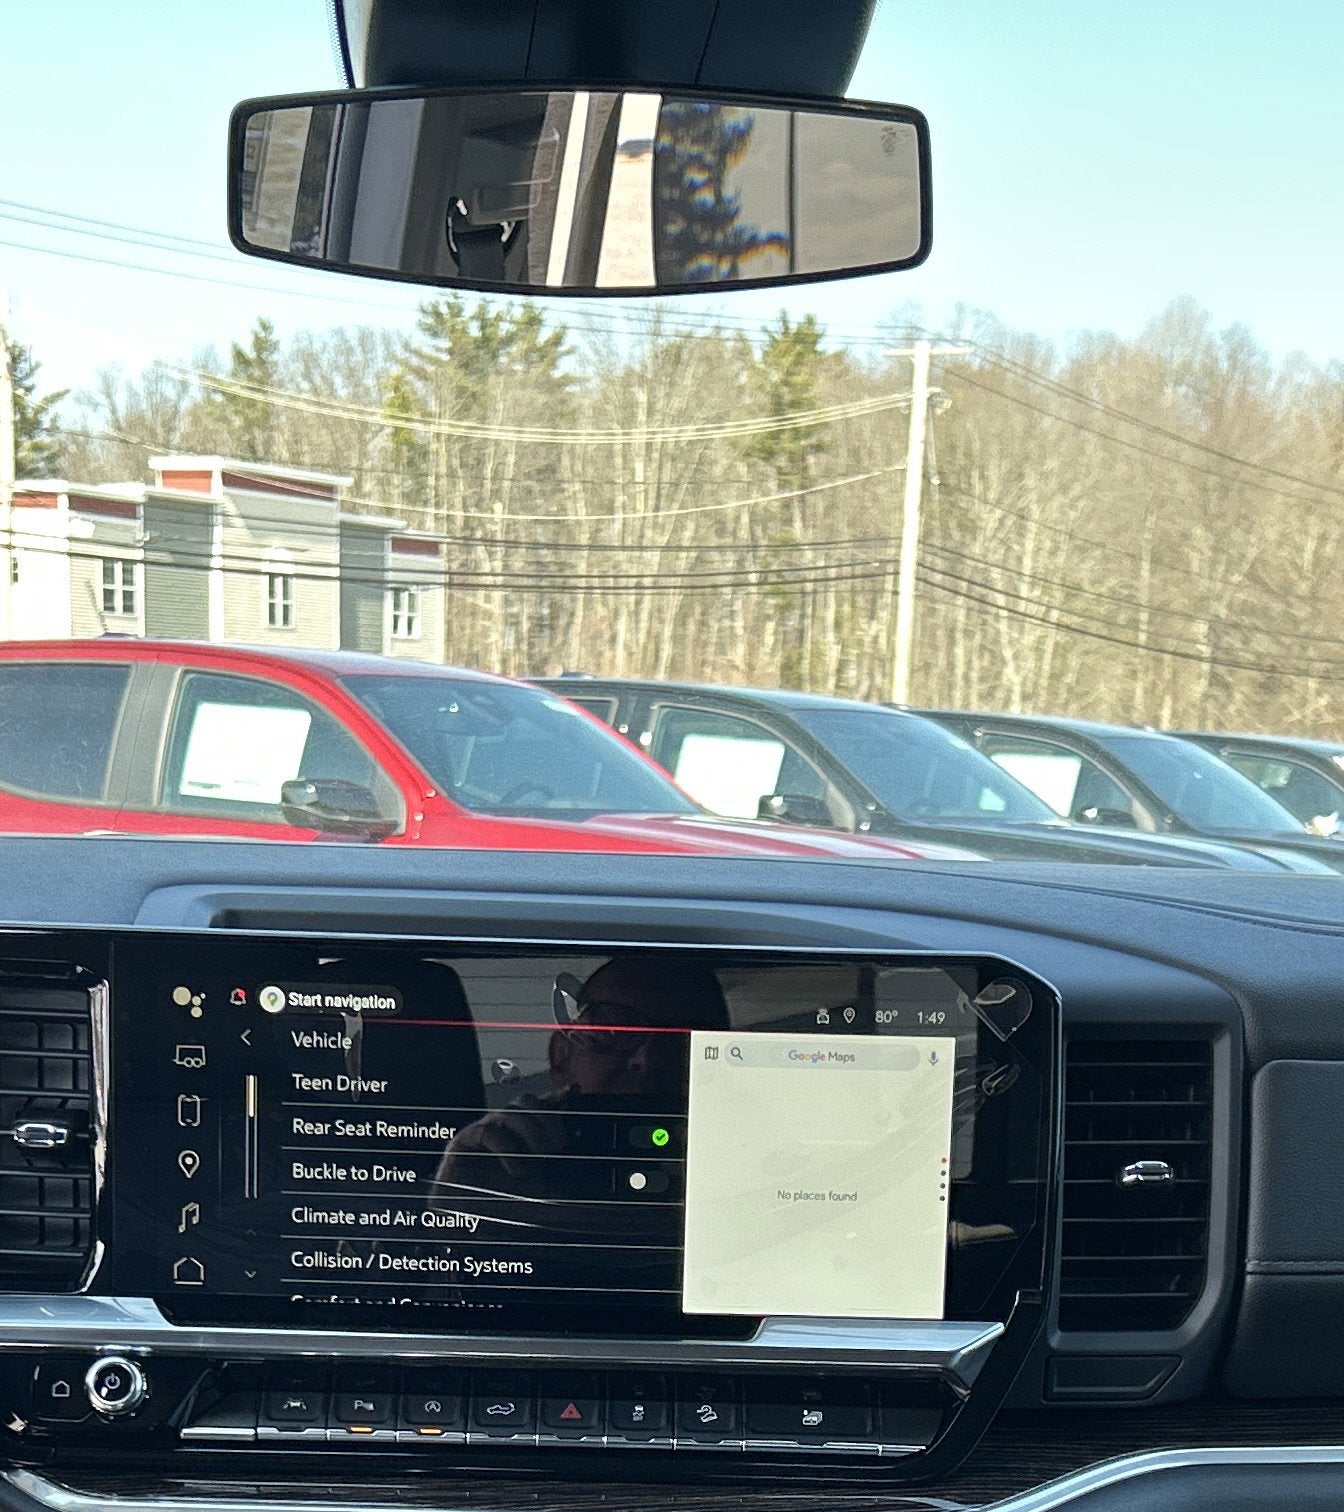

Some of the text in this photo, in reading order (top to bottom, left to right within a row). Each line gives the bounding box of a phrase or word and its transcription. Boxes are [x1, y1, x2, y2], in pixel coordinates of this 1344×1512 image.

[288, 991, 396, 1011] Start navigation
[916, 1011, 946, 1025] 1:49
[291, 1030, 353, 1050] Vehicle
[788, 1049, 856, 1064] Google Maps
[291, 1073, 388, 1093] Teen Driver
[292, 1117, 457, 1140] Rear Seat Reminder
[292, 1162, 417, 1183] Buckle to Drive
[777, 1190, 858, 1202] No places found
[291, 1206, 481, 1234] Climate and Air Quality
[291, 1251, 363, 1270] Collision
[378, 1253, 460, 1273] Detection
[463, 1256, 534, 1277] Systems
